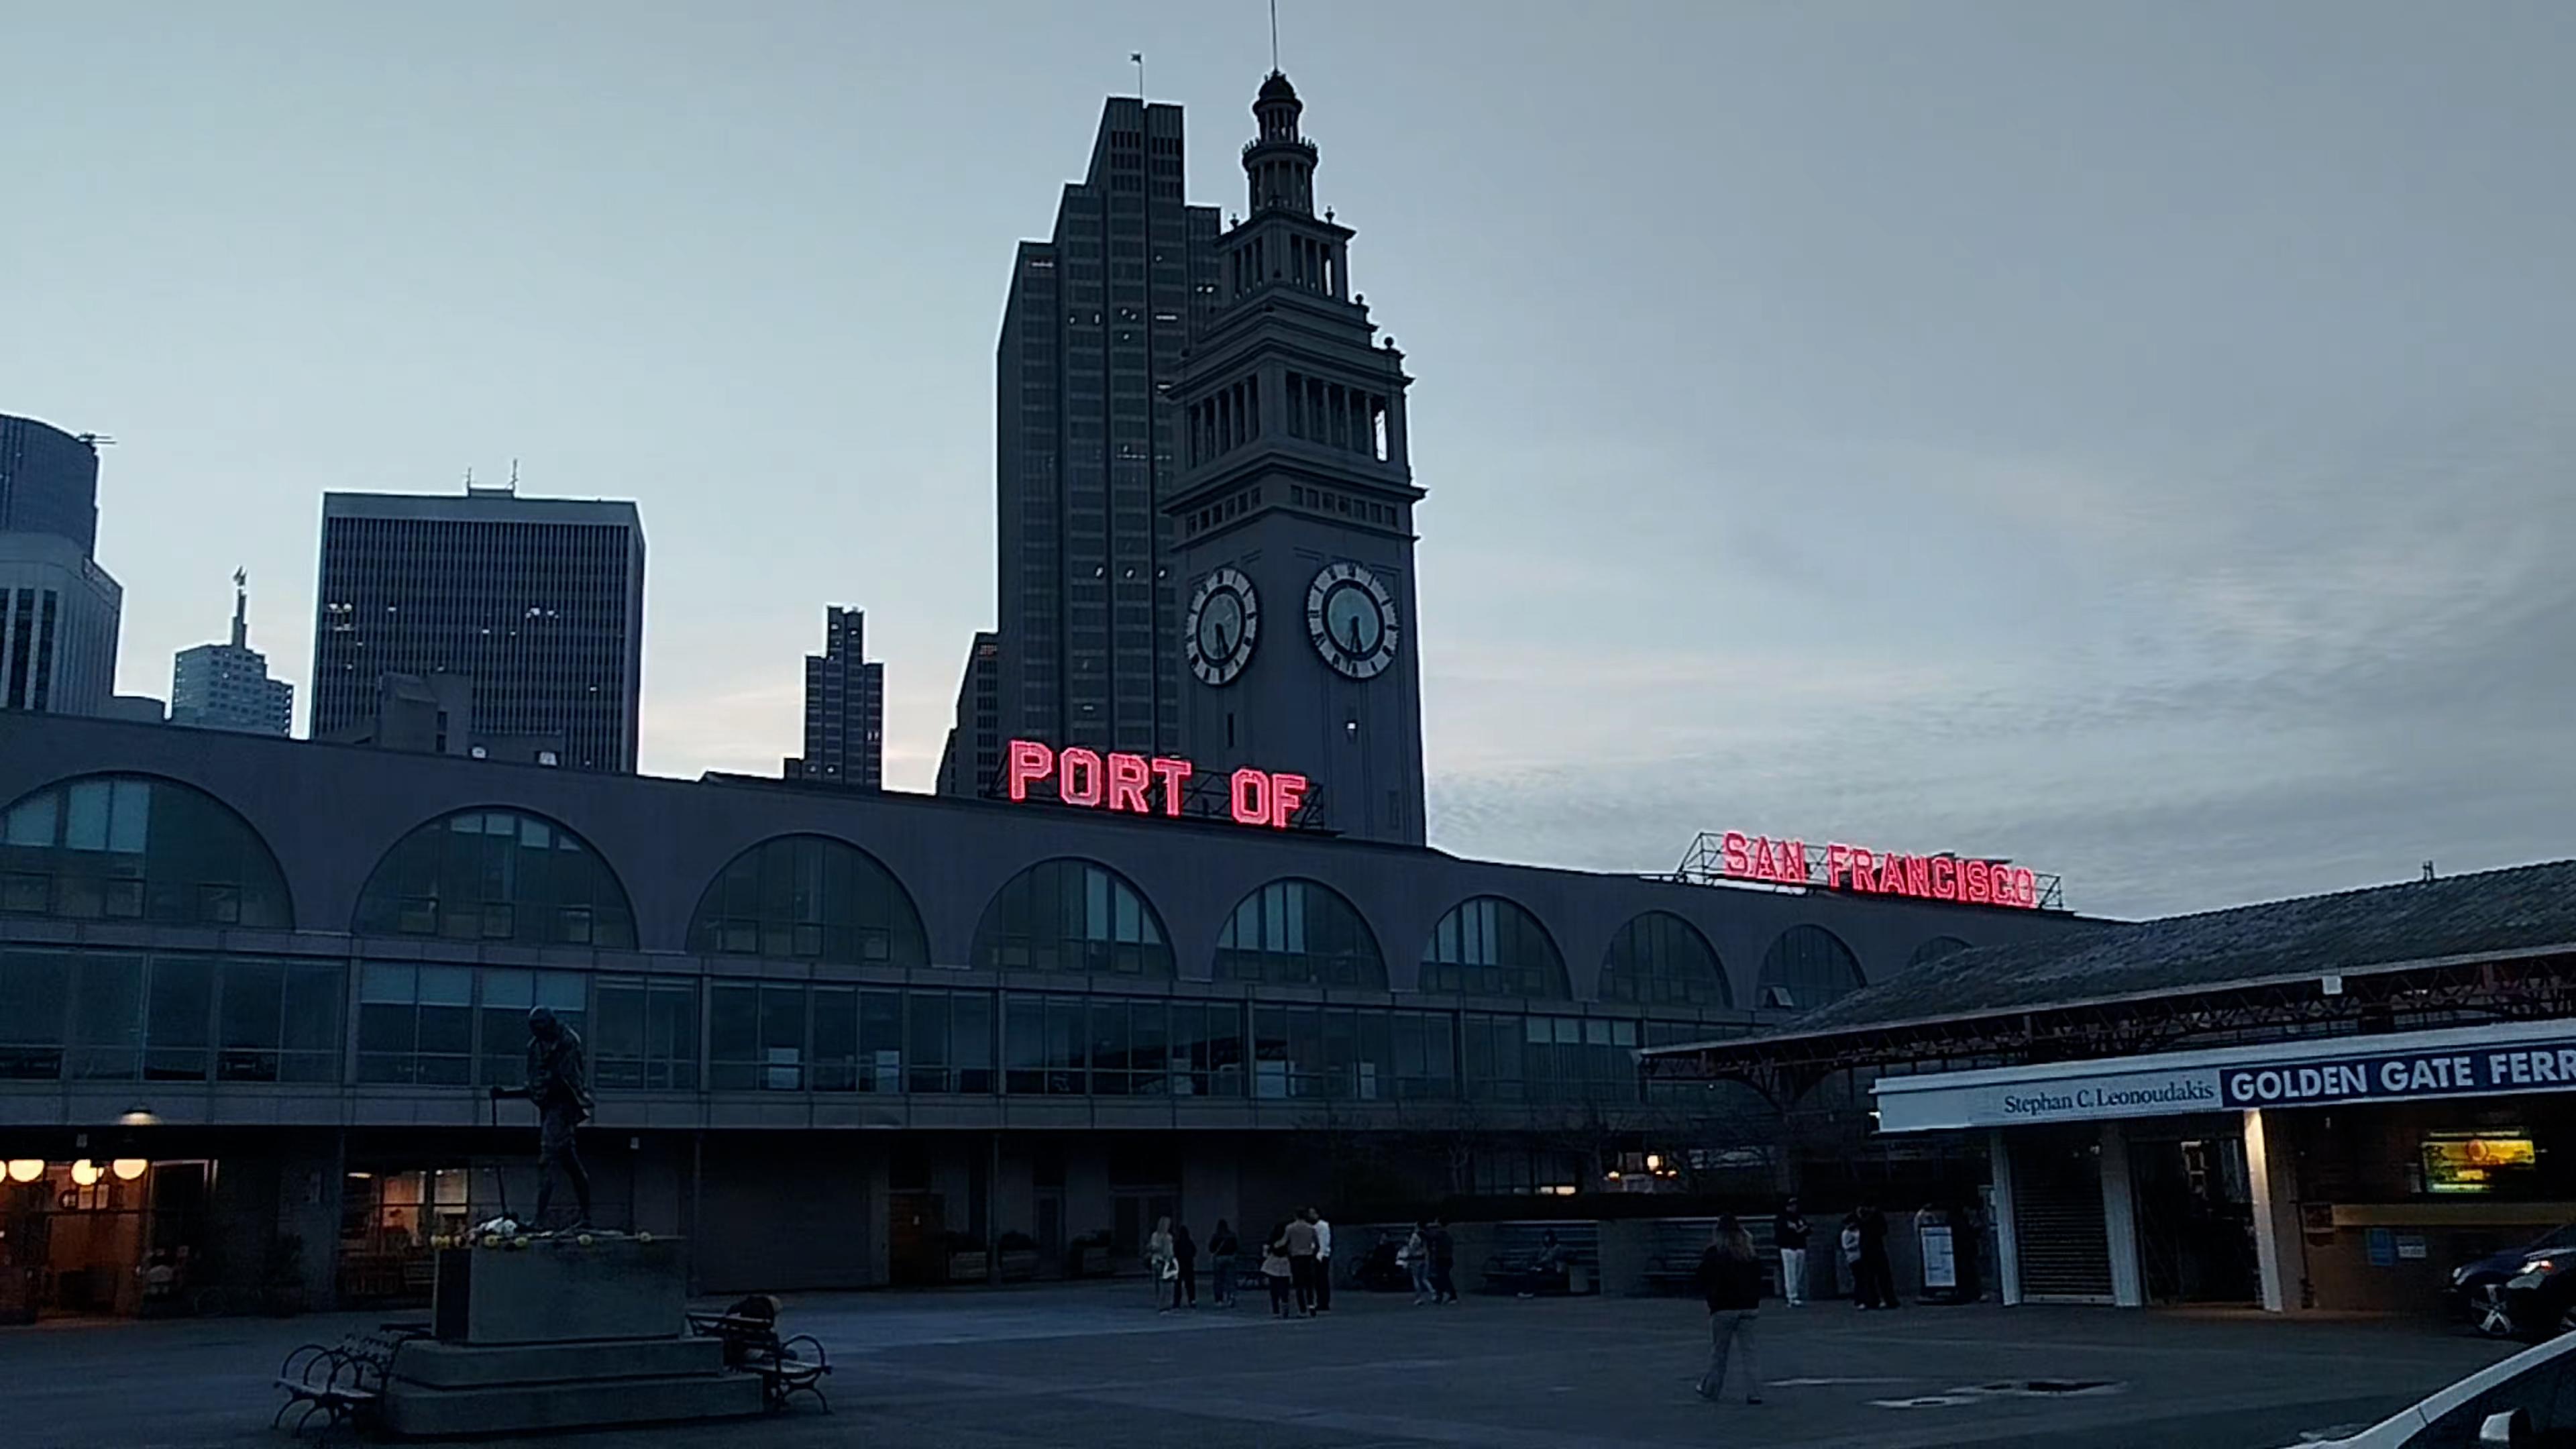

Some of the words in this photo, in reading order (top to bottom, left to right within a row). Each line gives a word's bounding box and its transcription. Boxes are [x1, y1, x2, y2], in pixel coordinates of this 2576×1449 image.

[1008, 739, 1193, 818] PORT
[1230, 766, 1308, 830] OF
[1723, 830, 1806, 885] SAN
[1826, 843, 2035, 910] FRANCISCO
[2004, 1093, 2073, 1116] Stephan
[2078, 1089, 2094, 1107] C.
[2097, 1081, 2214, 1106] Leonoudakis
[2230, 1064, 2368, 1102] GOLDEN
[2380, 1055, 2475, 1092] GATE
[2488, 1049, 2576, 1085] FERR
